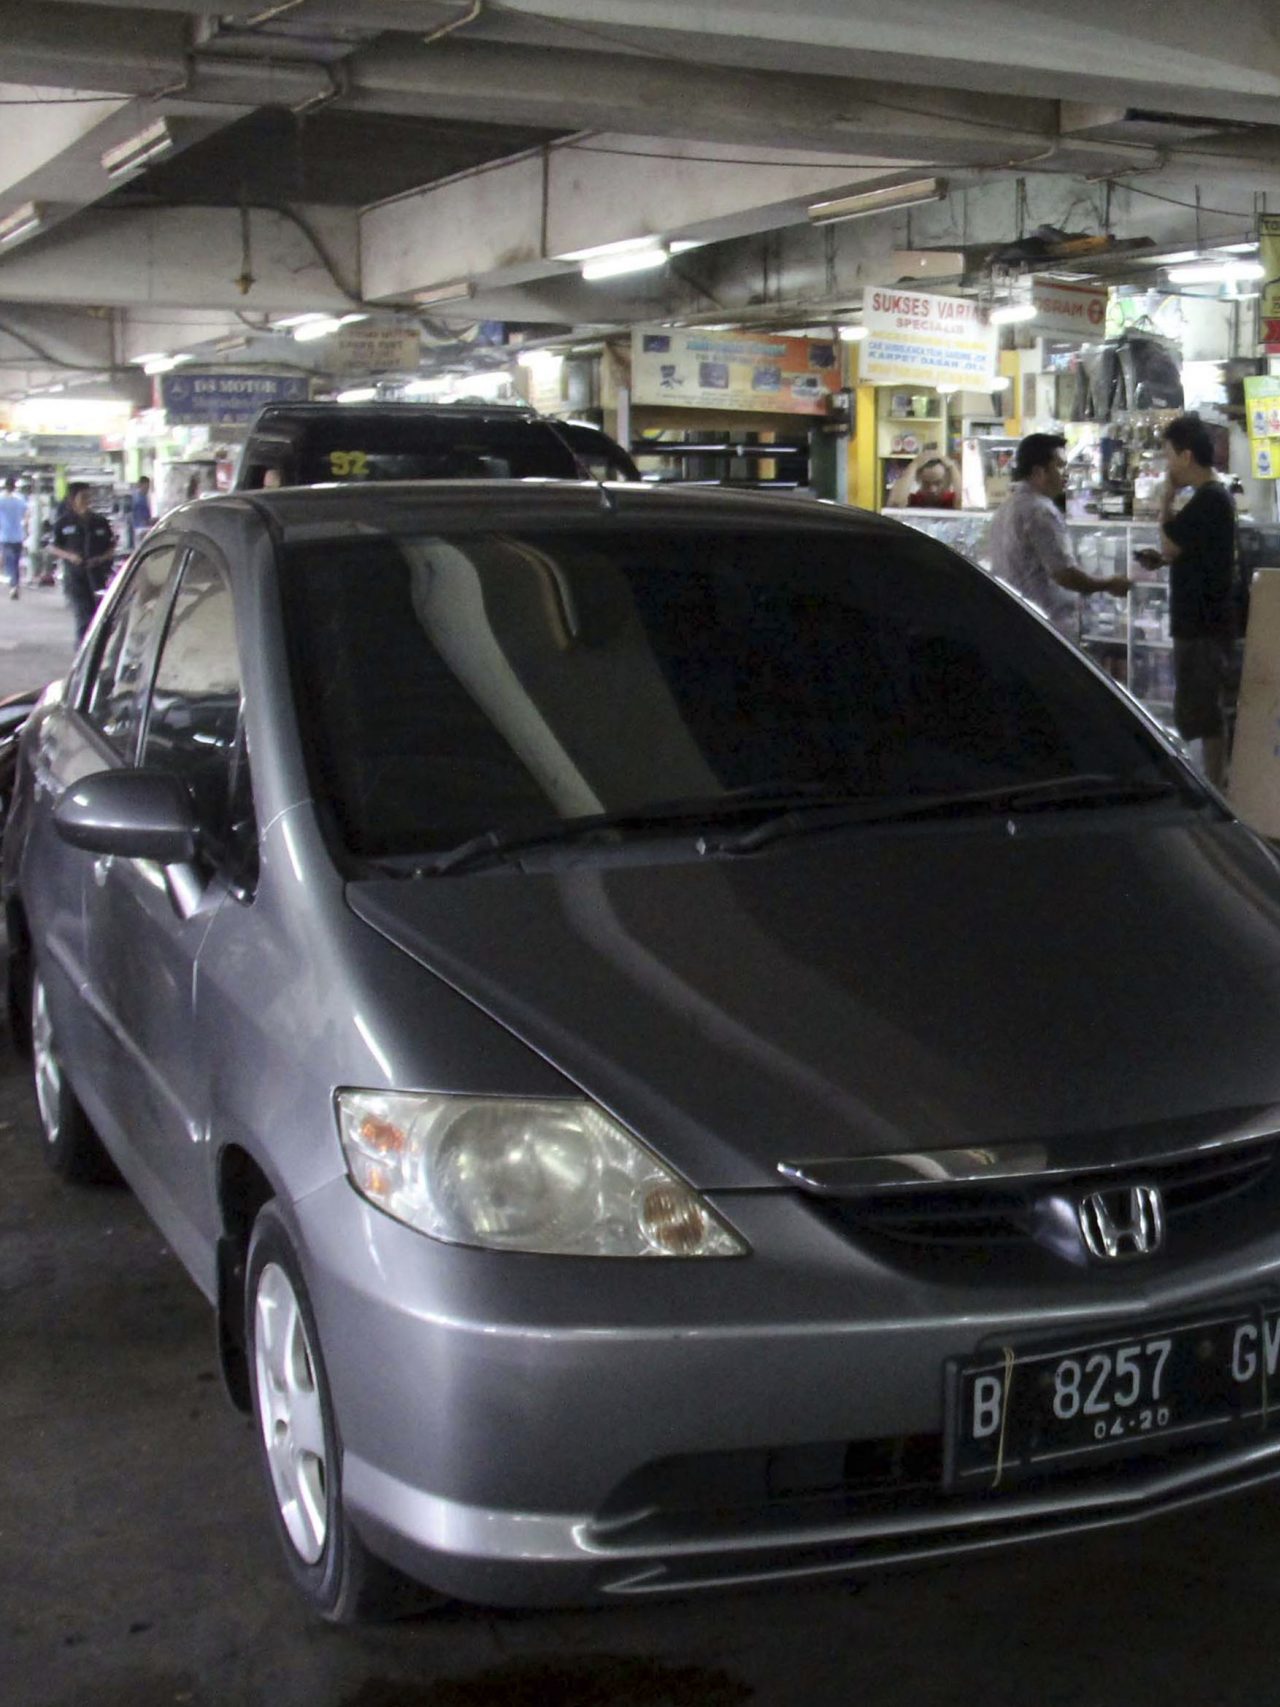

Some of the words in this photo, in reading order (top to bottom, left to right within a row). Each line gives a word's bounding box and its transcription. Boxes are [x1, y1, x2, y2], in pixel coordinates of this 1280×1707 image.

[872, 292, 930, 318] SUKSES
[972, 1376, 1001, 1439] B
[1052, 1339, 1173, 1419] 8257
